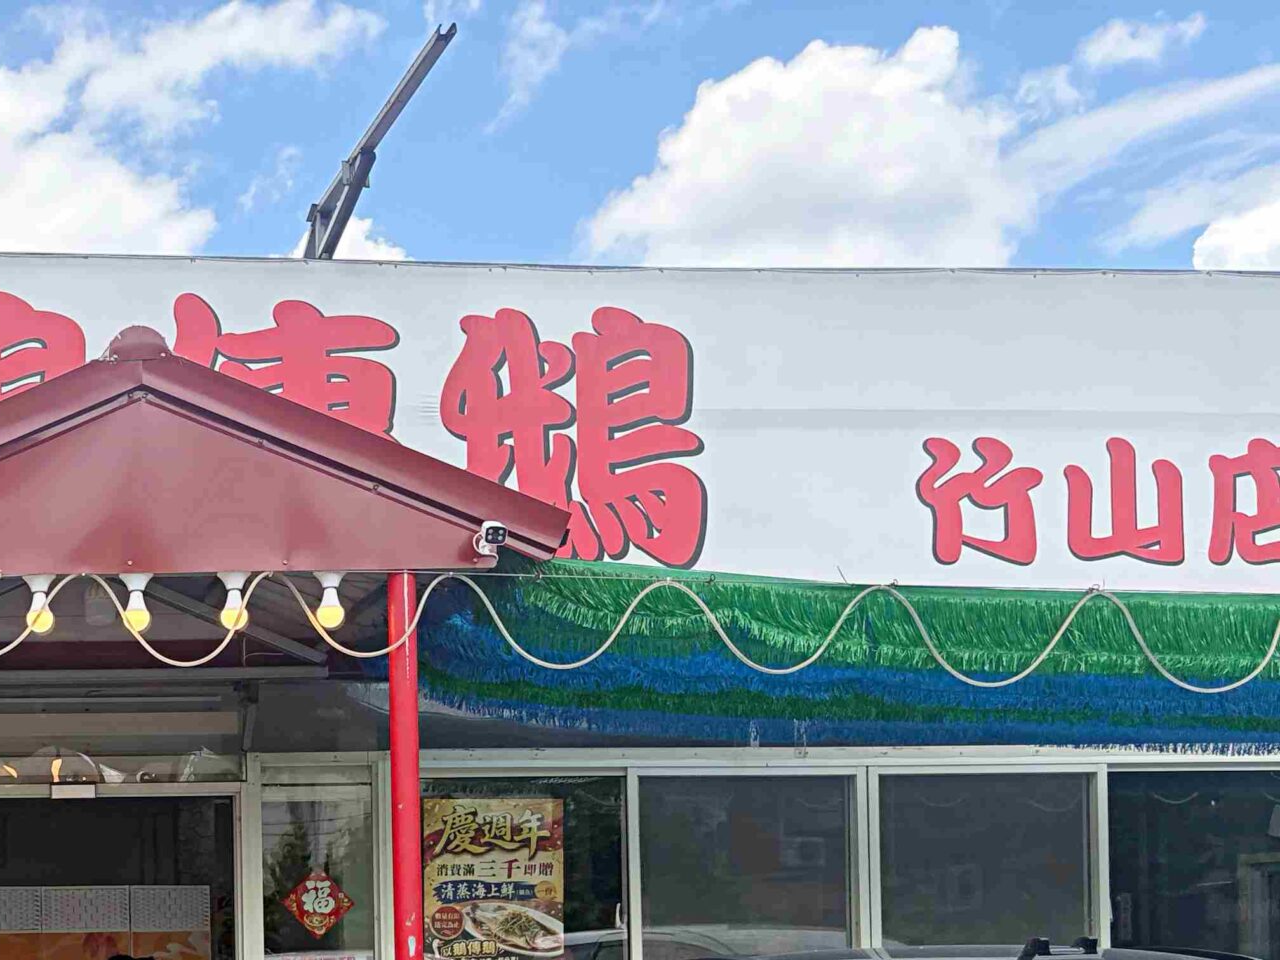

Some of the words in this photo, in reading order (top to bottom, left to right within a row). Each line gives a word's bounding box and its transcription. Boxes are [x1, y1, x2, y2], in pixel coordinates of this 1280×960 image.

[915, 437, 1280, 566] 竹山店
[431, 805, 551, 859] 慶週年
[436, 859, 554, 879] 消費滿三千即贈
[302, 880, 335, 914] 福
